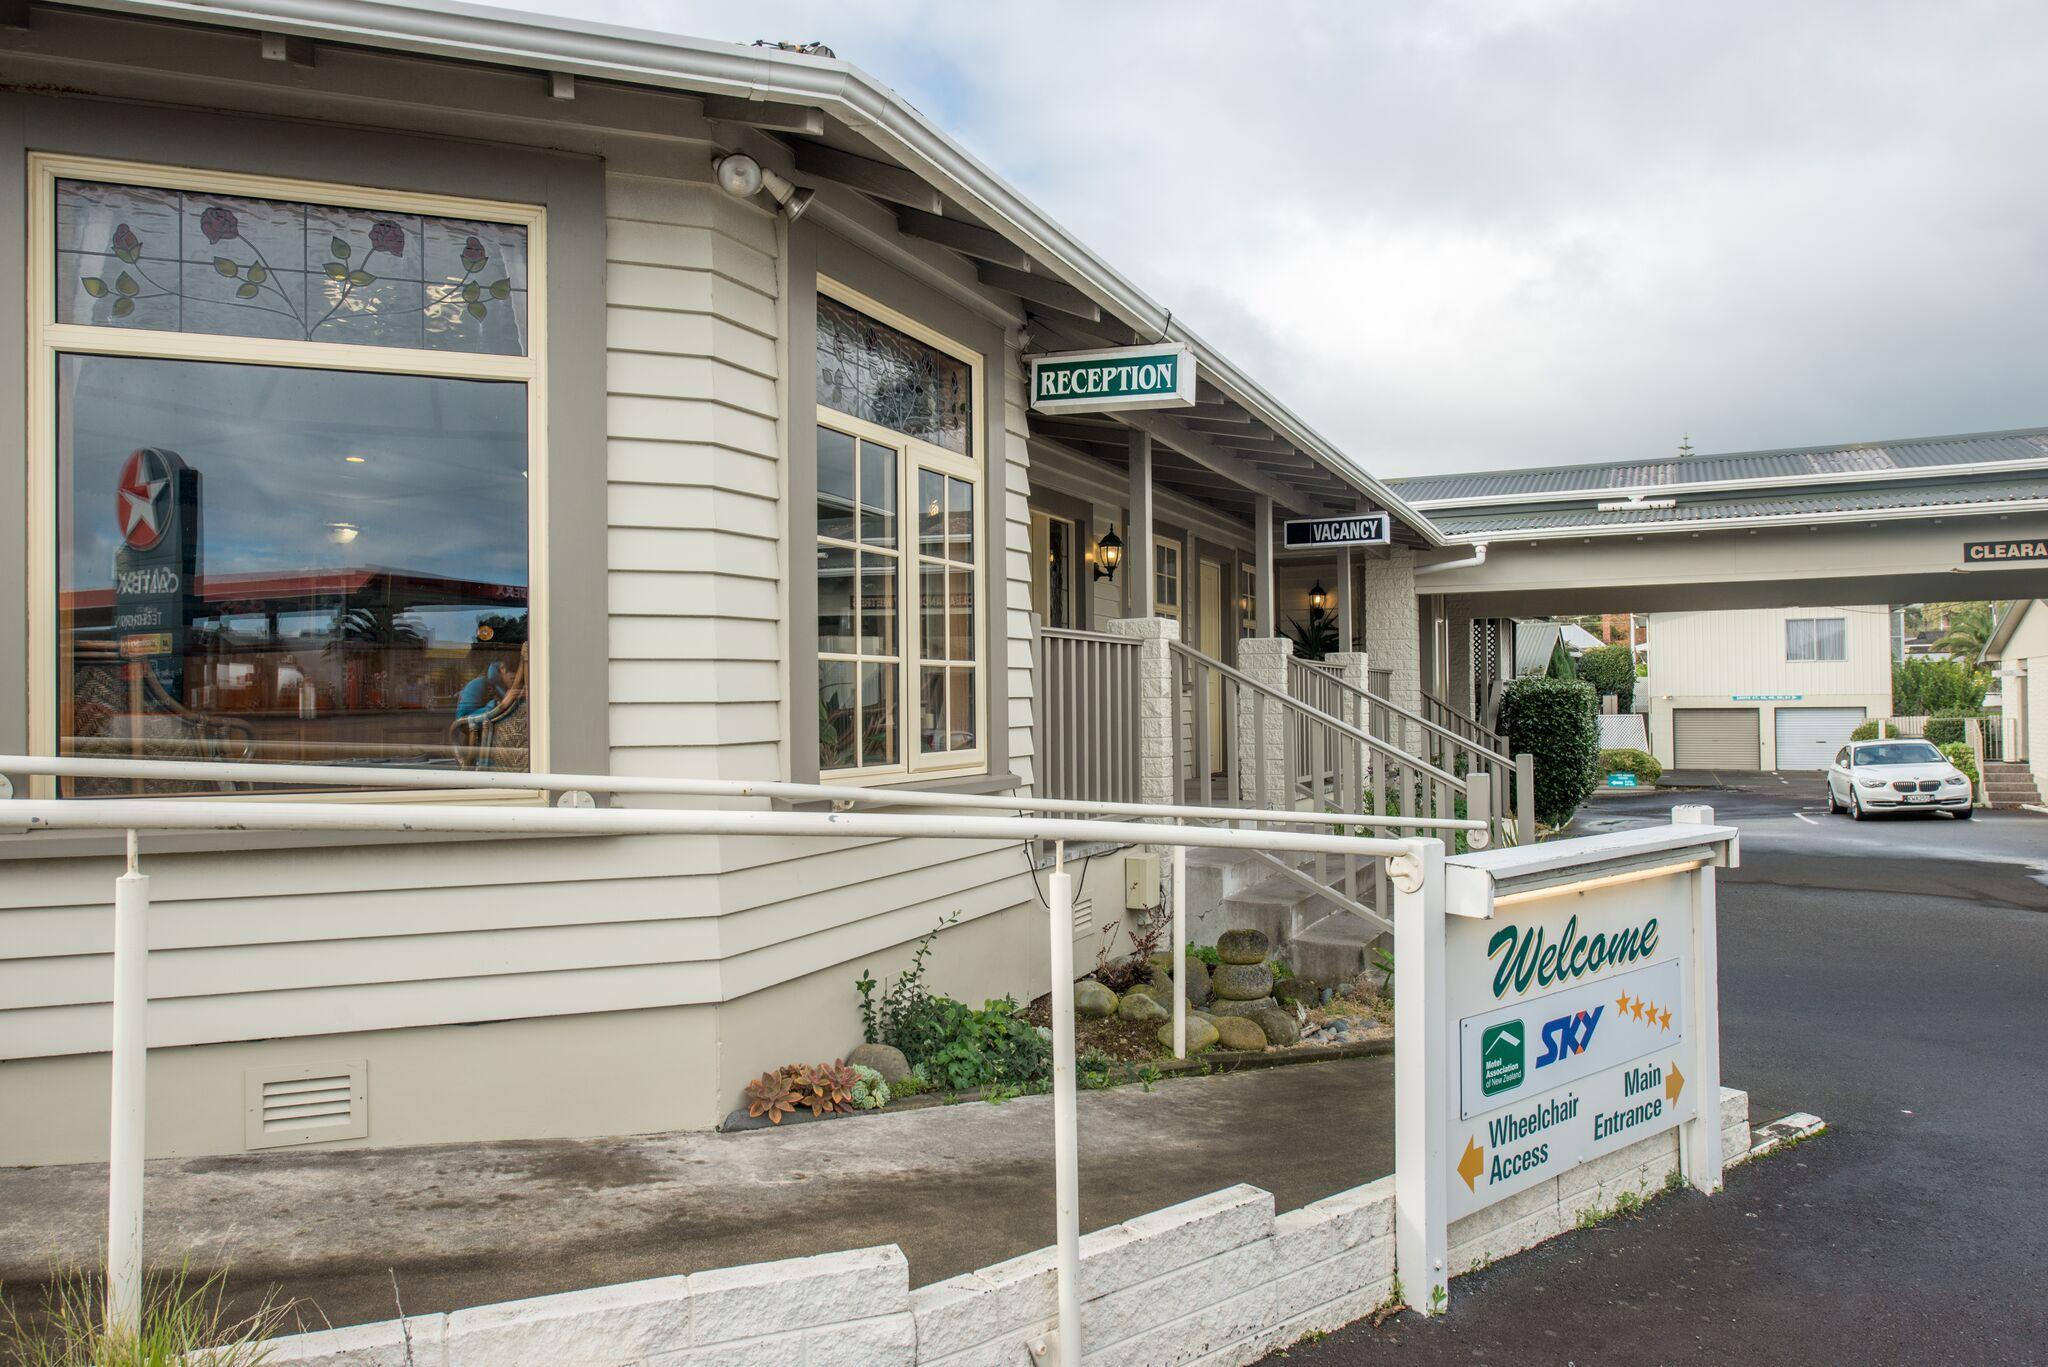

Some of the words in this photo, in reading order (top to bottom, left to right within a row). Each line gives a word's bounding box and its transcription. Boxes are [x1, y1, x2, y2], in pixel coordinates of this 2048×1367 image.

[1040, 363, 1173, 396] RECEPTION
[1313, 520, 1379, 541] VACANCY
[1970, 542, 2048, 559] CLEARA
[1487, 914, 1660, 1000] Welcome
[1535, 1004, 1605, 1069] SKY
[1486, 1057, 1502, 1070] Motel
[1486, 1063, 1519, 1079] Association
[1486, 1079, 1492, 1088] of
[1492, 1077, 1502, 1086] New
[1503, 1070, 1522, 1082] Zealand
[1624, 1064, 1662, 1097] Main
[1489, 1092, 1579, 1149] Wheelchair
[1594, 1098, 1662, 1141] Entrance
[1489, 1140, 1549, 1185] Access
